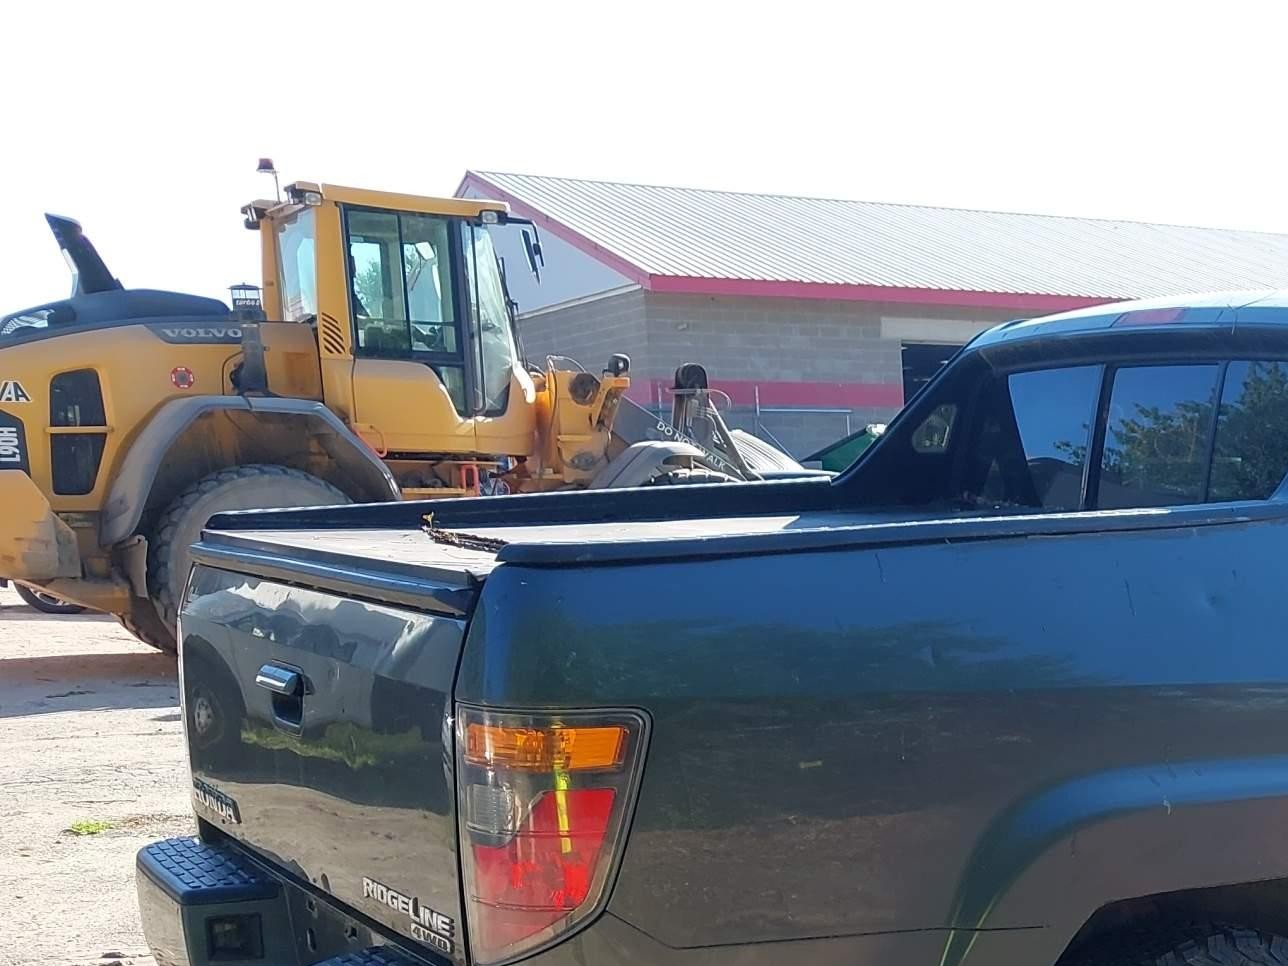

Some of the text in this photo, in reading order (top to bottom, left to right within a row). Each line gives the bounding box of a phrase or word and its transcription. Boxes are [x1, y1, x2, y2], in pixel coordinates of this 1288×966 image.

[161, 328, 242, 338] VOLVO
[656, 421, 673, 436] DO
[362, 876, 453, 937] RIDGELINE
[412, 924, 450, 951] 4WD
